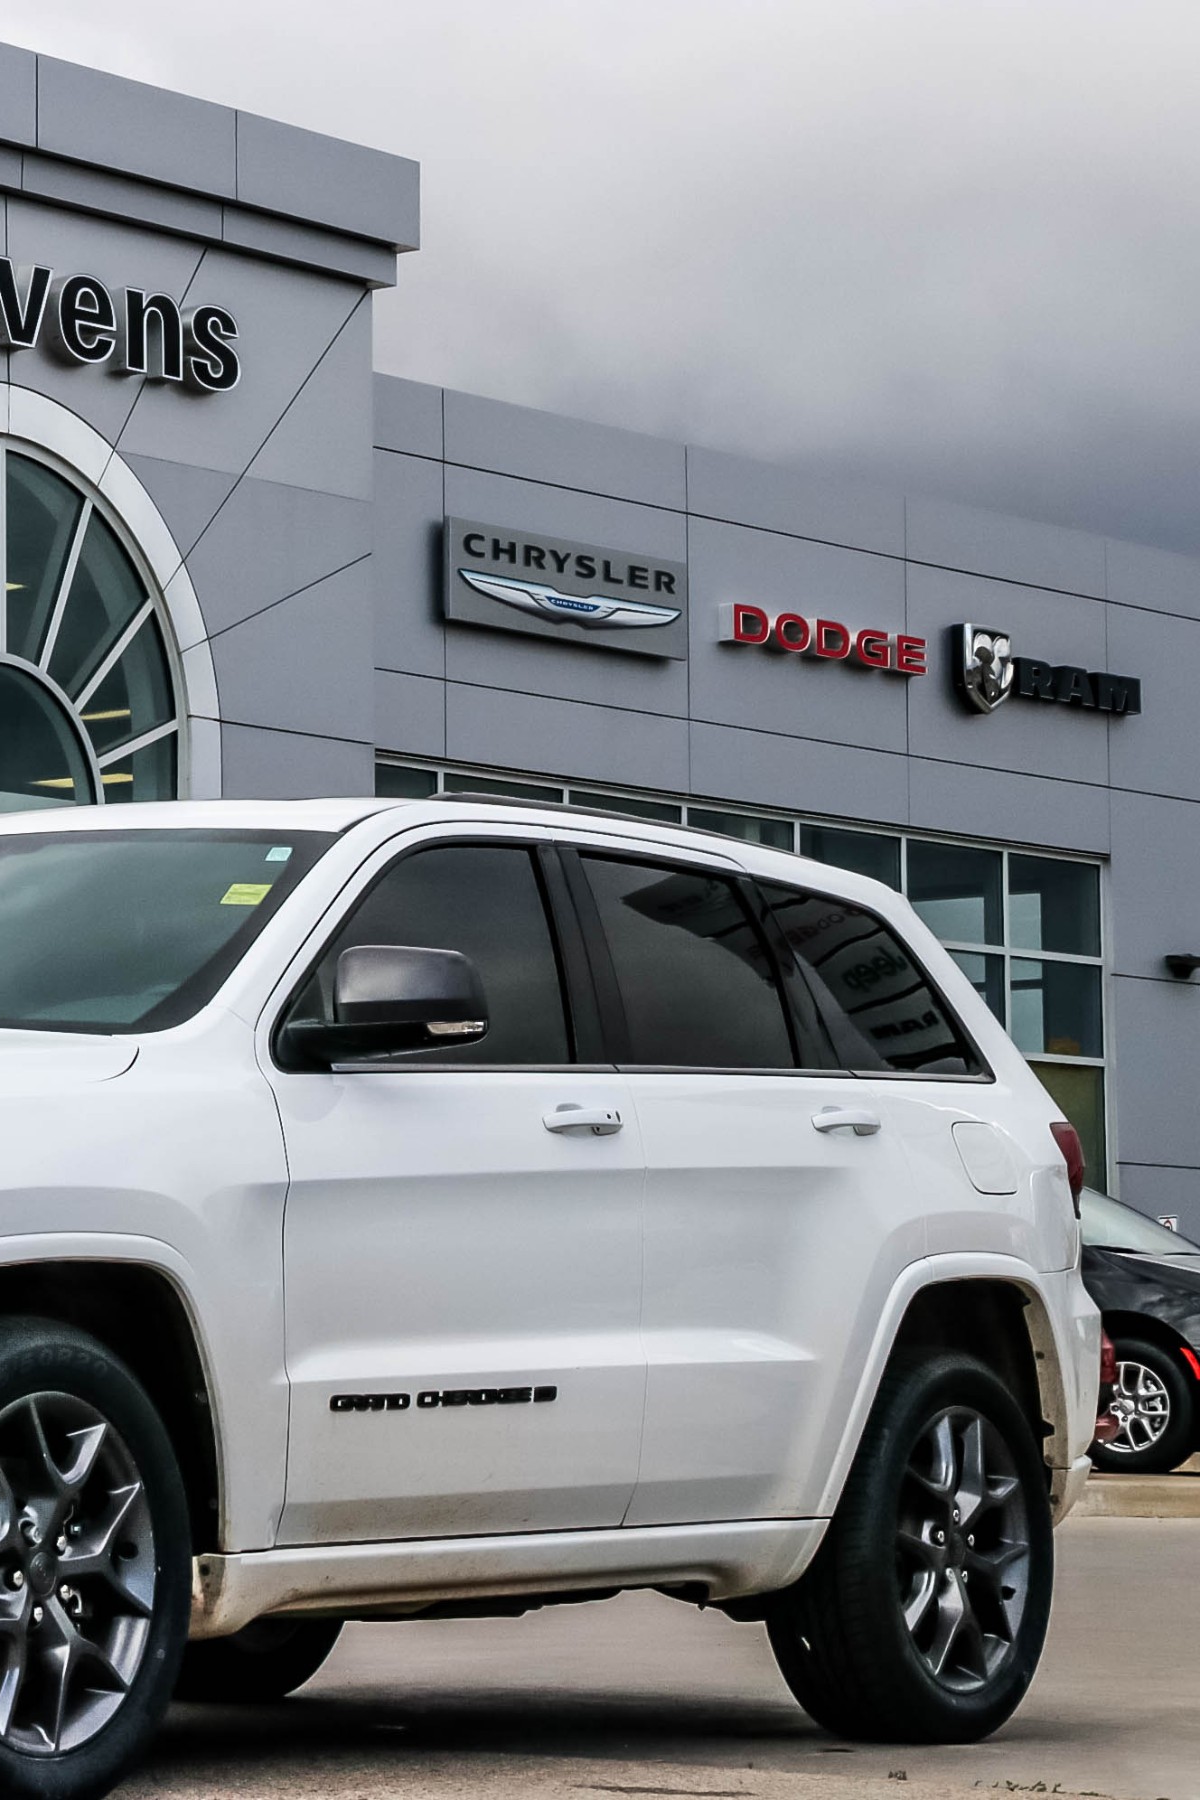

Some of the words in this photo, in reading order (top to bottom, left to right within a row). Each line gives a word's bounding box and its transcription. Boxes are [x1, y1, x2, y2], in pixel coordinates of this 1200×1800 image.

[463, 533, 676, 595] CHRYSLER
[550, 598, 594, 611] CHRYSLER
[733, 603, 928, 676] DODGE
[1016, 658, 1141, 715] RAM
